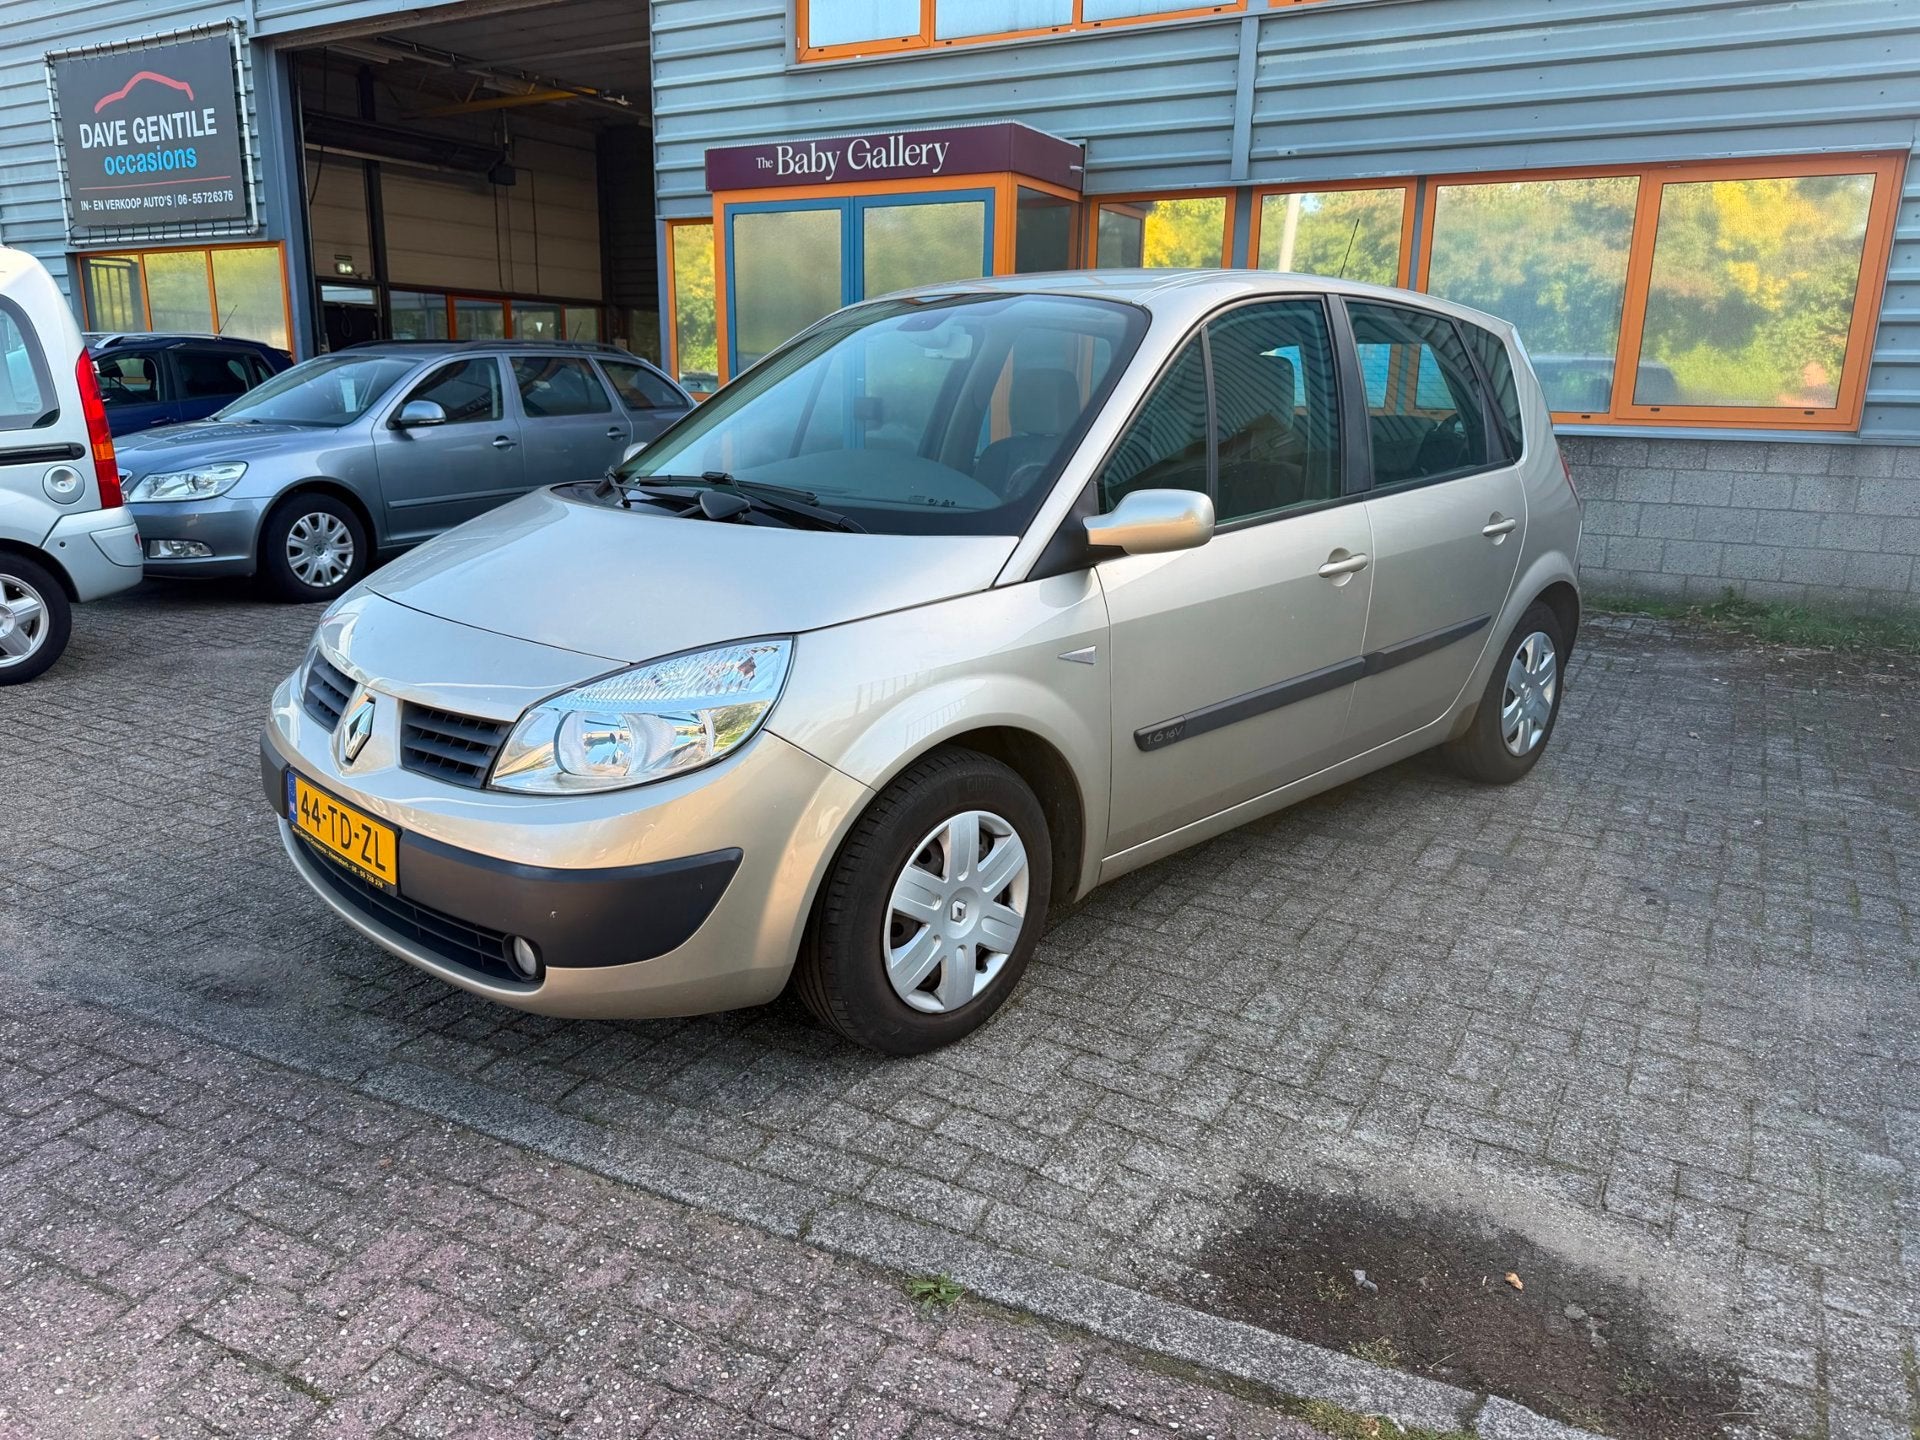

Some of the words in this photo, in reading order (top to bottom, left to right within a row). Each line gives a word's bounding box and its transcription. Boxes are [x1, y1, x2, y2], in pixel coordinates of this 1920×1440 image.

[79, 120, 128, 149] DAVE
[132, 107, 218, 144] GENTILE
[104, 145, 197, 176] occasions
[756, 157, 774, 170] The
[775, 143, 840, 181] Baby
[846, 135, 950, 173] Gallery
[80, 200, 92, 211] IN-
[94, 200, 105, 211] EN
[106, 197, 142, 210] VERKOOP
[143, 194, 173, 208] AUTO'S
[1146, 730, 1164, 745] 1.6
[301, 790, 386, 872] 44-TD-ZL
